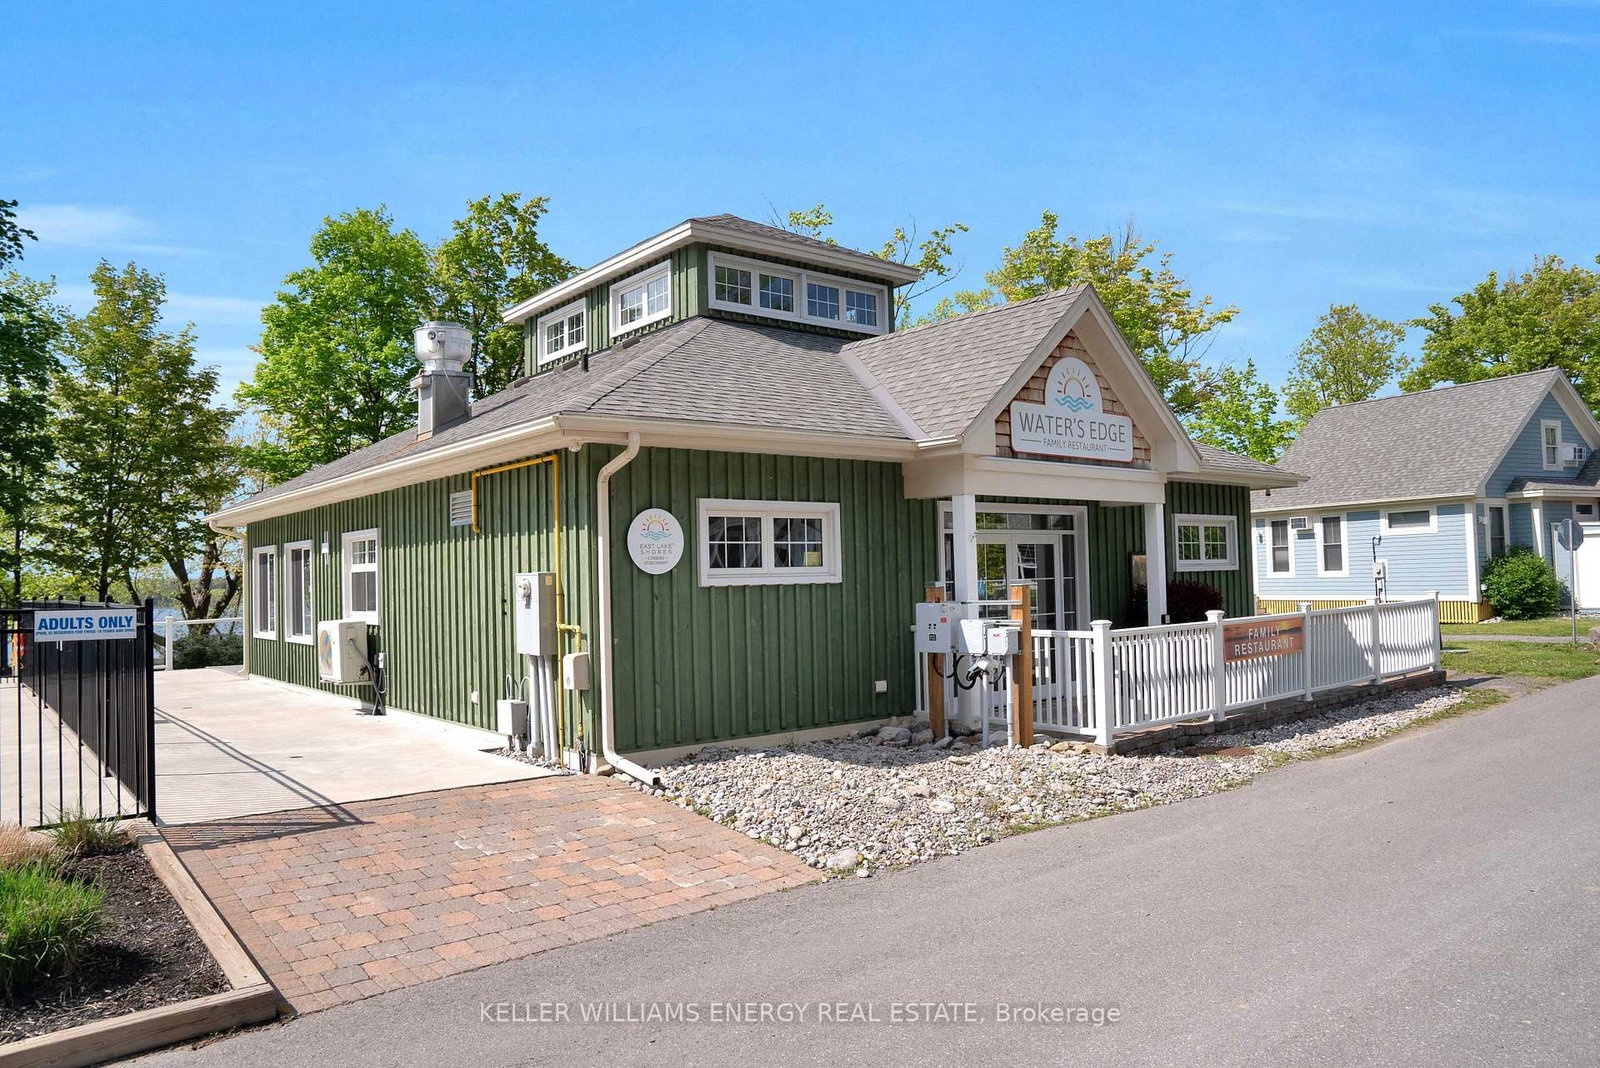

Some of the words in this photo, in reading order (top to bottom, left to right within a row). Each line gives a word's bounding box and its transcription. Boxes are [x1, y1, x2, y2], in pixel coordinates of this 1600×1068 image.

[1019, 411, 1085, 438] WATER'S
[1090, 421, 1126, 443] EDGE
[1043, 438, 1067, 449] FAMILY
[1067, 440, 1108, 453] RESTAURANT
[38, 617, 93, 630] ADULTS
[98, 616, 133, 629] ONLY
[1248, 626, 1281, 640] FAMILY
[1234, 637, 1294, 656] RESTAURANT
